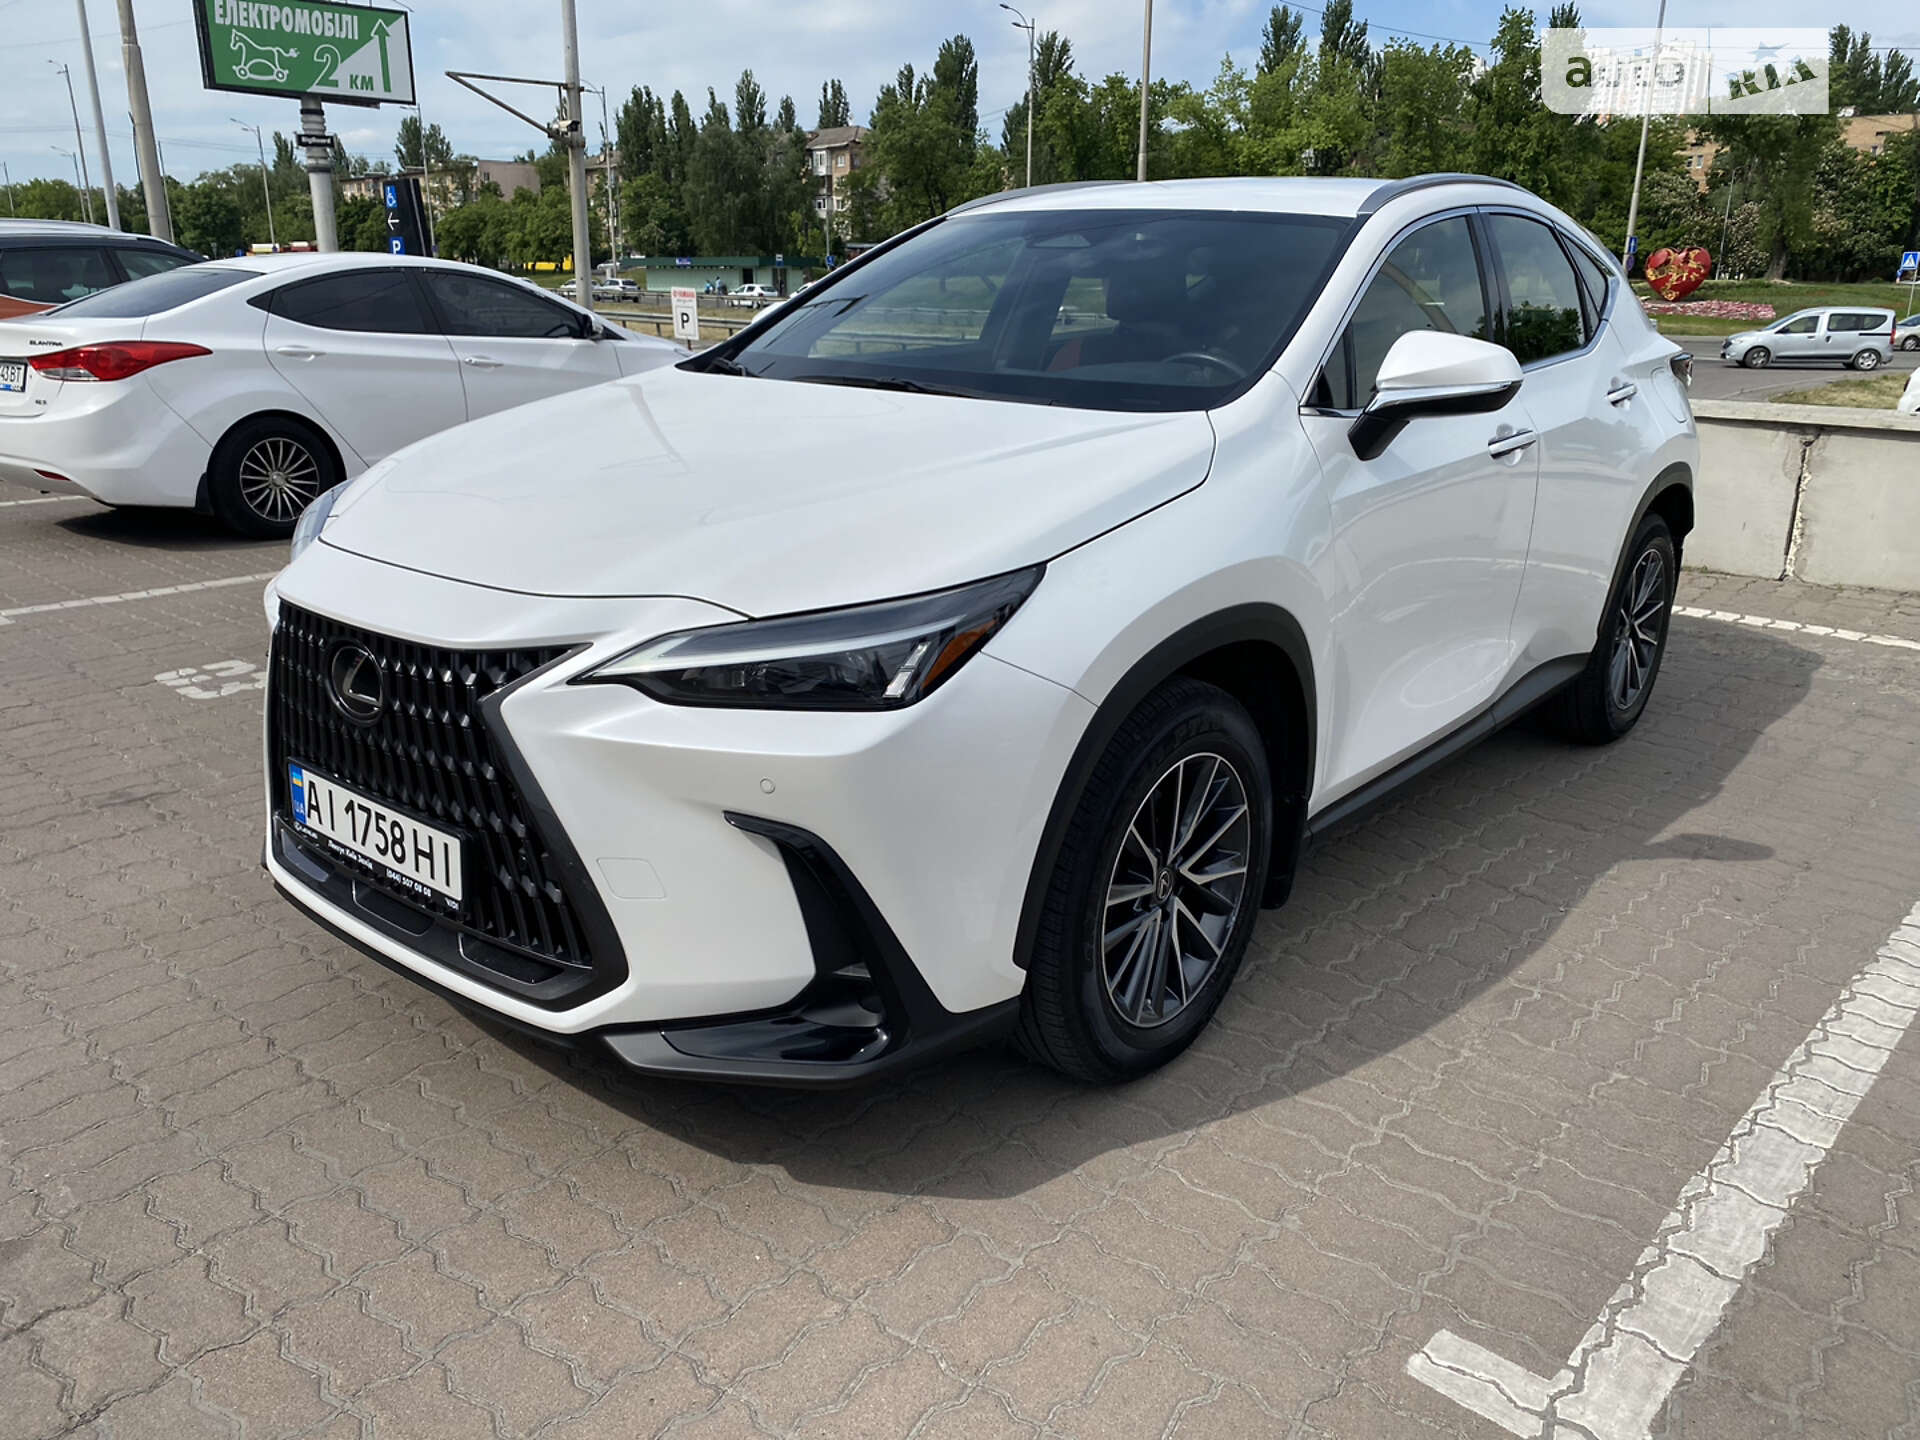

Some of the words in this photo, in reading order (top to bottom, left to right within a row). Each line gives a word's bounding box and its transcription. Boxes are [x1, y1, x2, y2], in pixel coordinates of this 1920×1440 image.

[214, 0, 359, 40] ЕЛЕКТРОМОБІЛІ
[313, 44, 341, 88] 2
[681, 312, 690, 329] P
[307, 780, 335, 831] AI
[344, 799, 406, 864] 1758
[413, 828, 450, 888] HI
